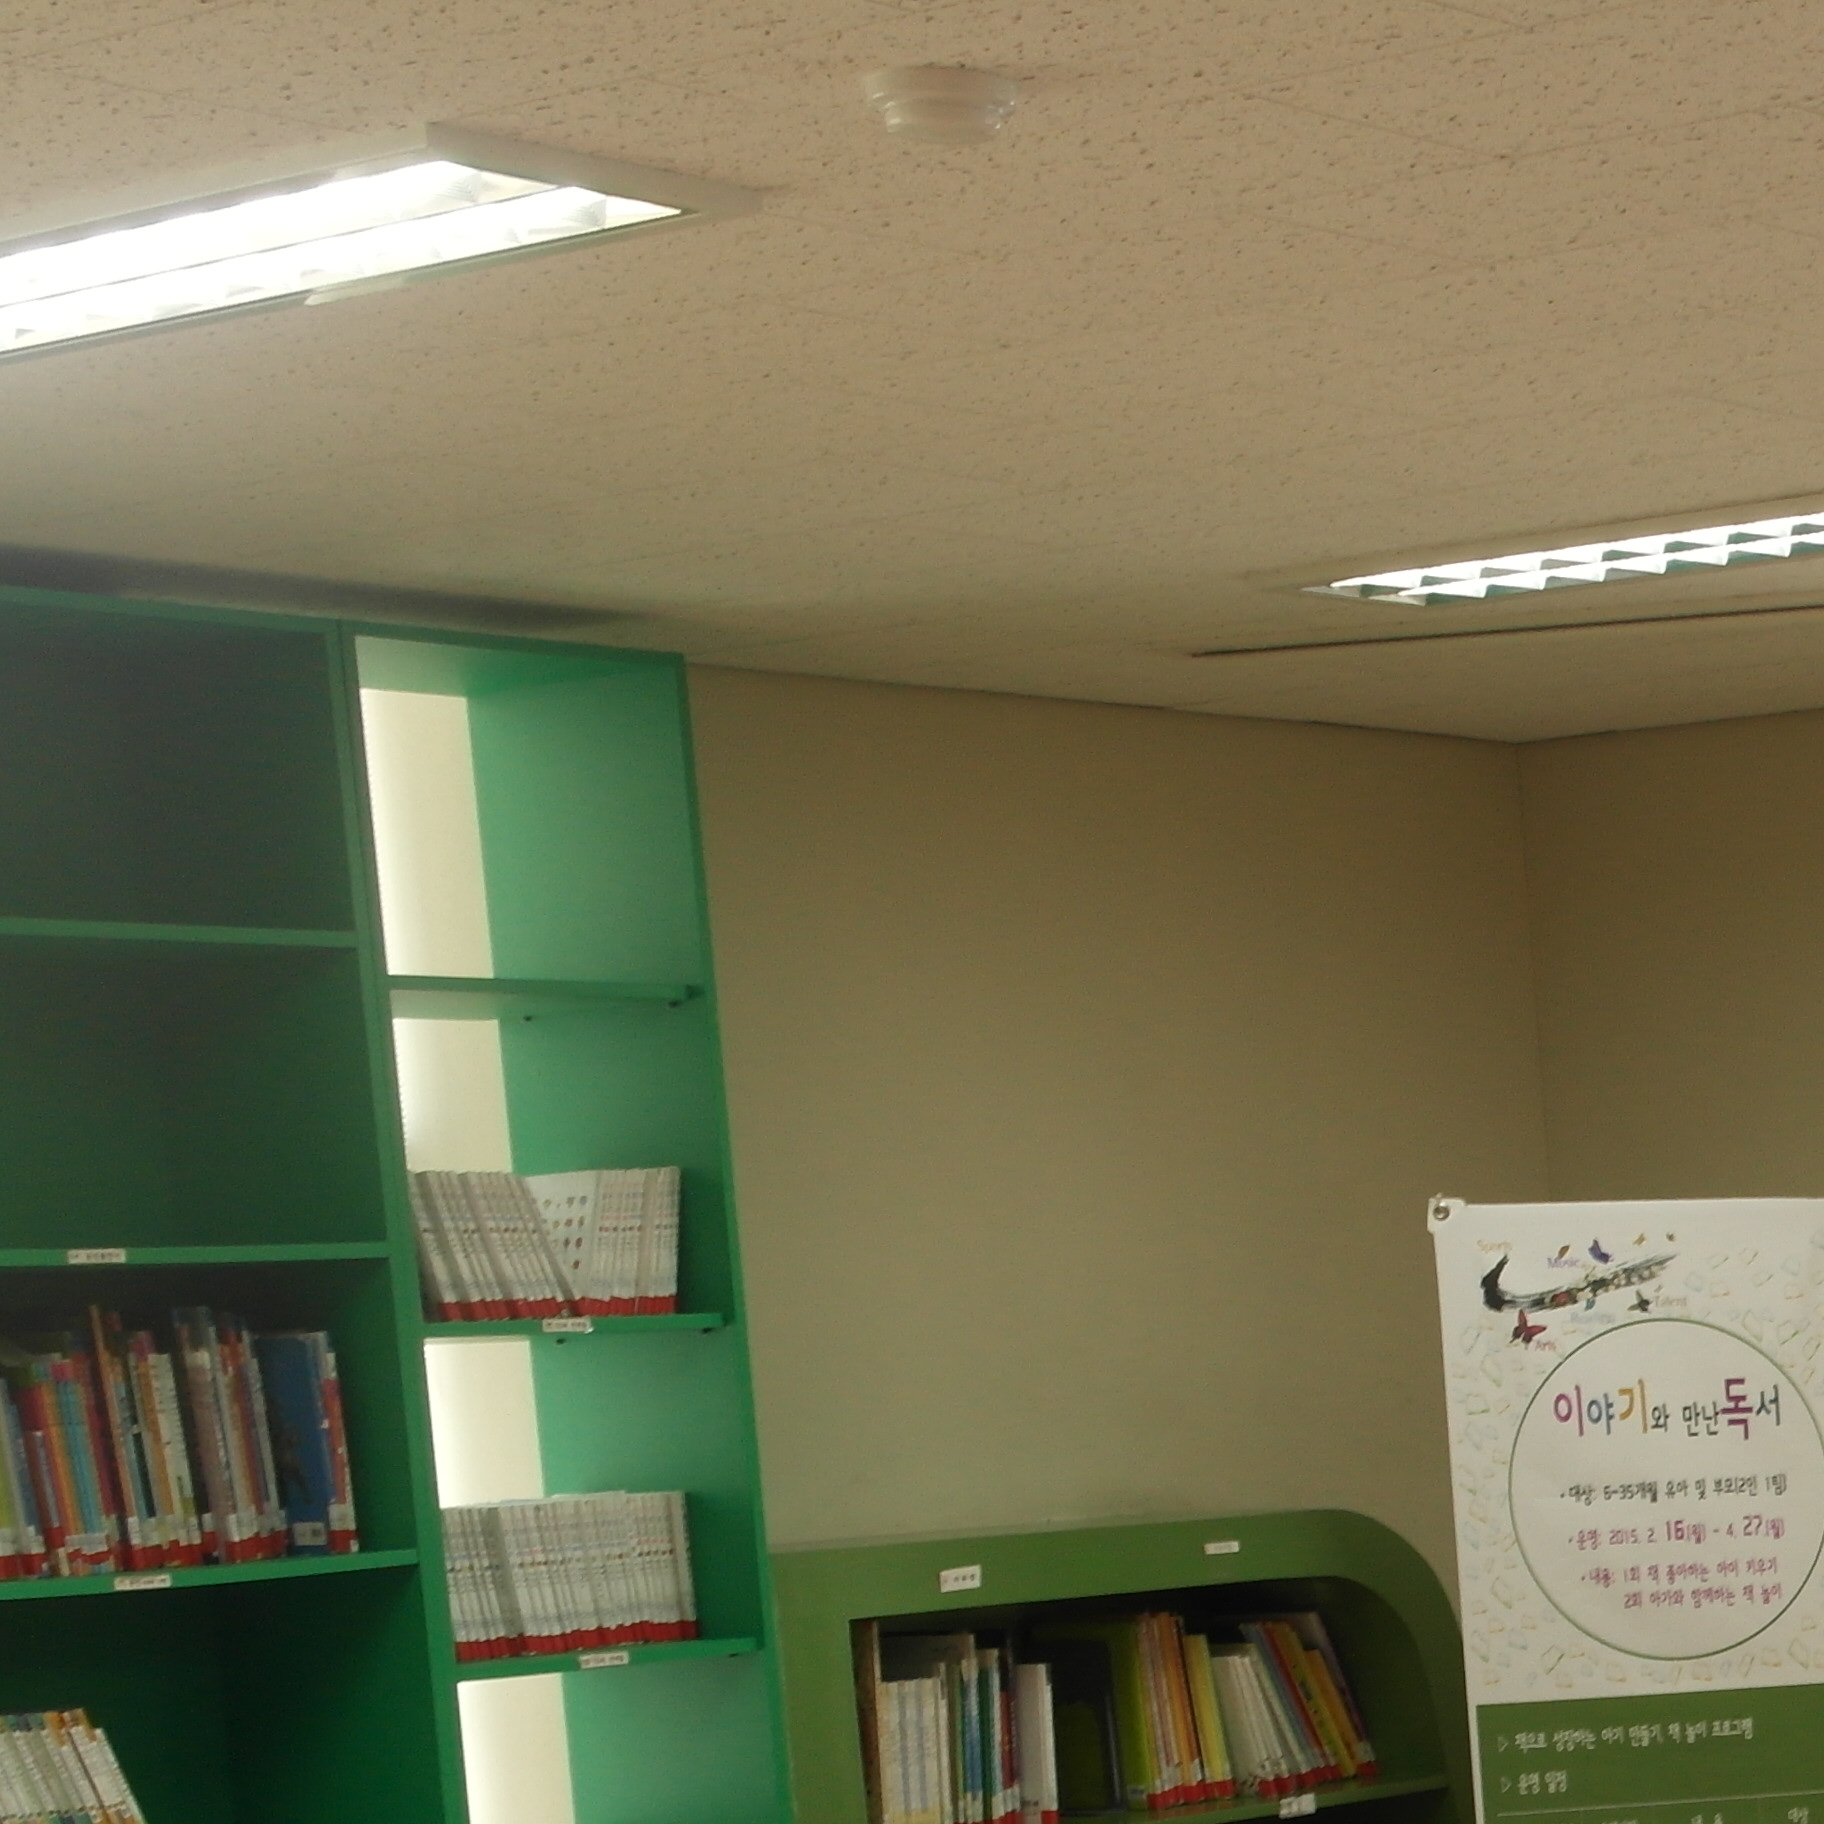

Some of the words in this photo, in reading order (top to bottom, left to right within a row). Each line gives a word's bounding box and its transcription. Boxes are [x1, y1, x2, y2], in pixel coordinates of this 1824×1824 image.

[1547, 1257, 1579, 1268] Music
[1654, 1295, 1687, 1306] Talent
[1553, 1378, 1670, 1438] 이야기와
[1665, 1480, 1689, 1499] 유아
